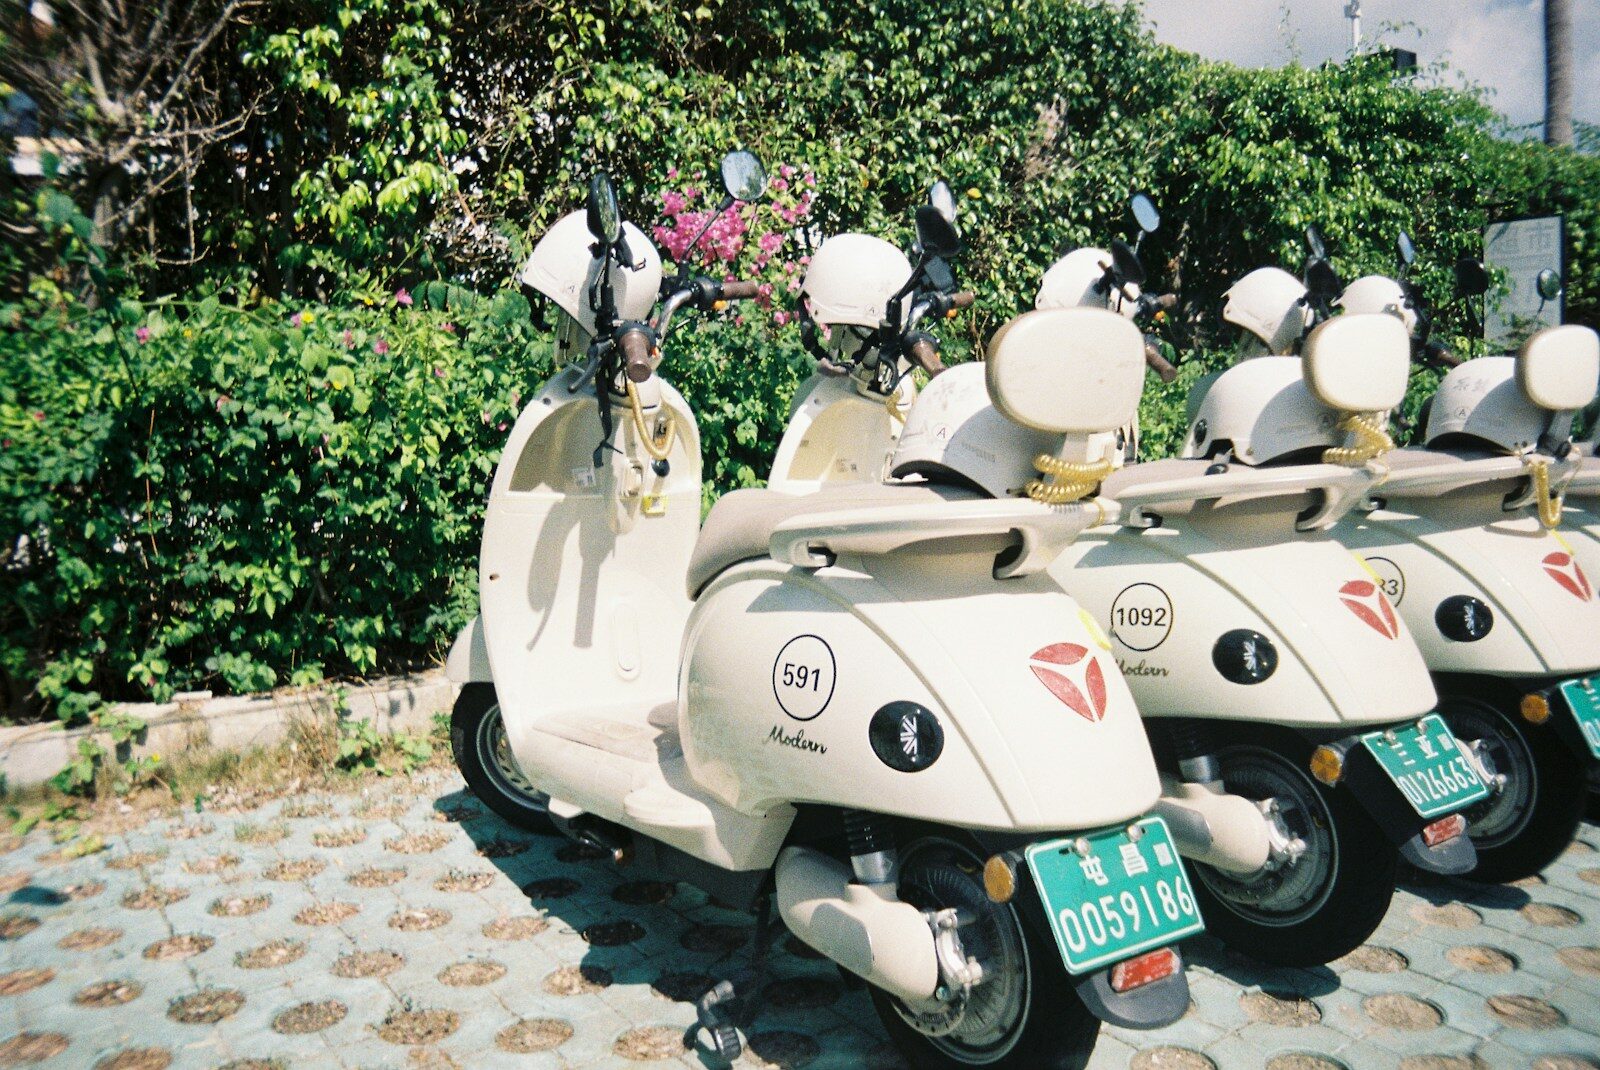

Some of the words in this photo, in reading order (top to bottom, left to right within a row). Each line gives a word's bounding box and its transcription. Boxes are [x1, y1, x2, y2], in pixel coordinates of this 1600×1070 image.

[936, 426, 946, 439] A
[1116, 607, 1167, 627] 1092
[782, 662, 821, 692] 591
[769, 724, 828, 755] Modern
[1397, 756, 1479, 805] 0126663
[1058, 875, 1194, 954] 0059186
